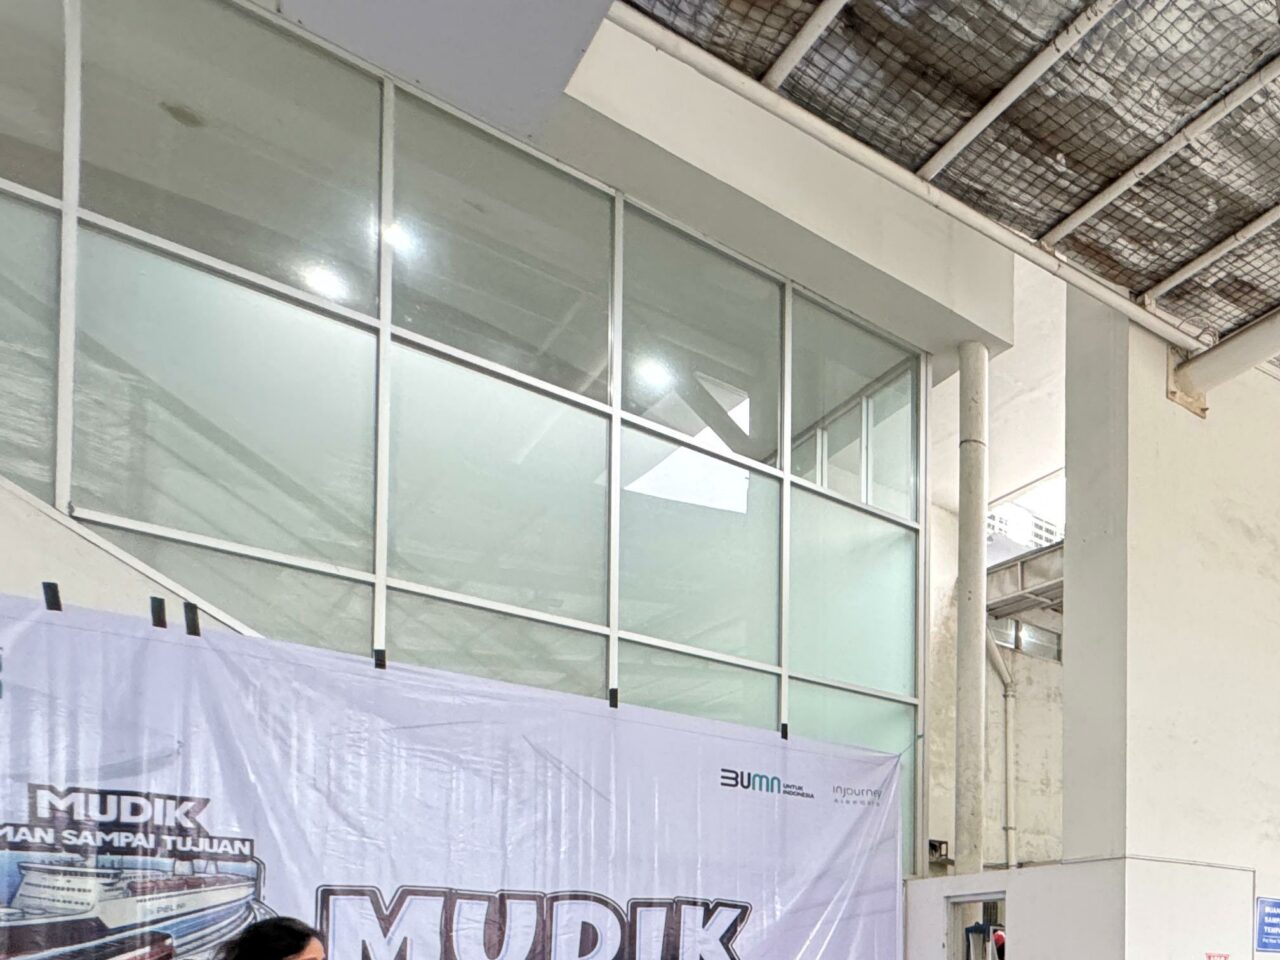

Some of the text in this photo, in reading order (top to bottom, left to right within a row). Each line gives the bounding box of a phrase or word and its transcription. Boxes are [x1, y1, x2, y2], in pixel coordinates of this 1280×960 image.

[36, 788, 203, 830] MUDIK
[782, 790, 815, 799] INDONESIA
[0, 825, 251, 856] MAN SAMPAI TUJUAN
